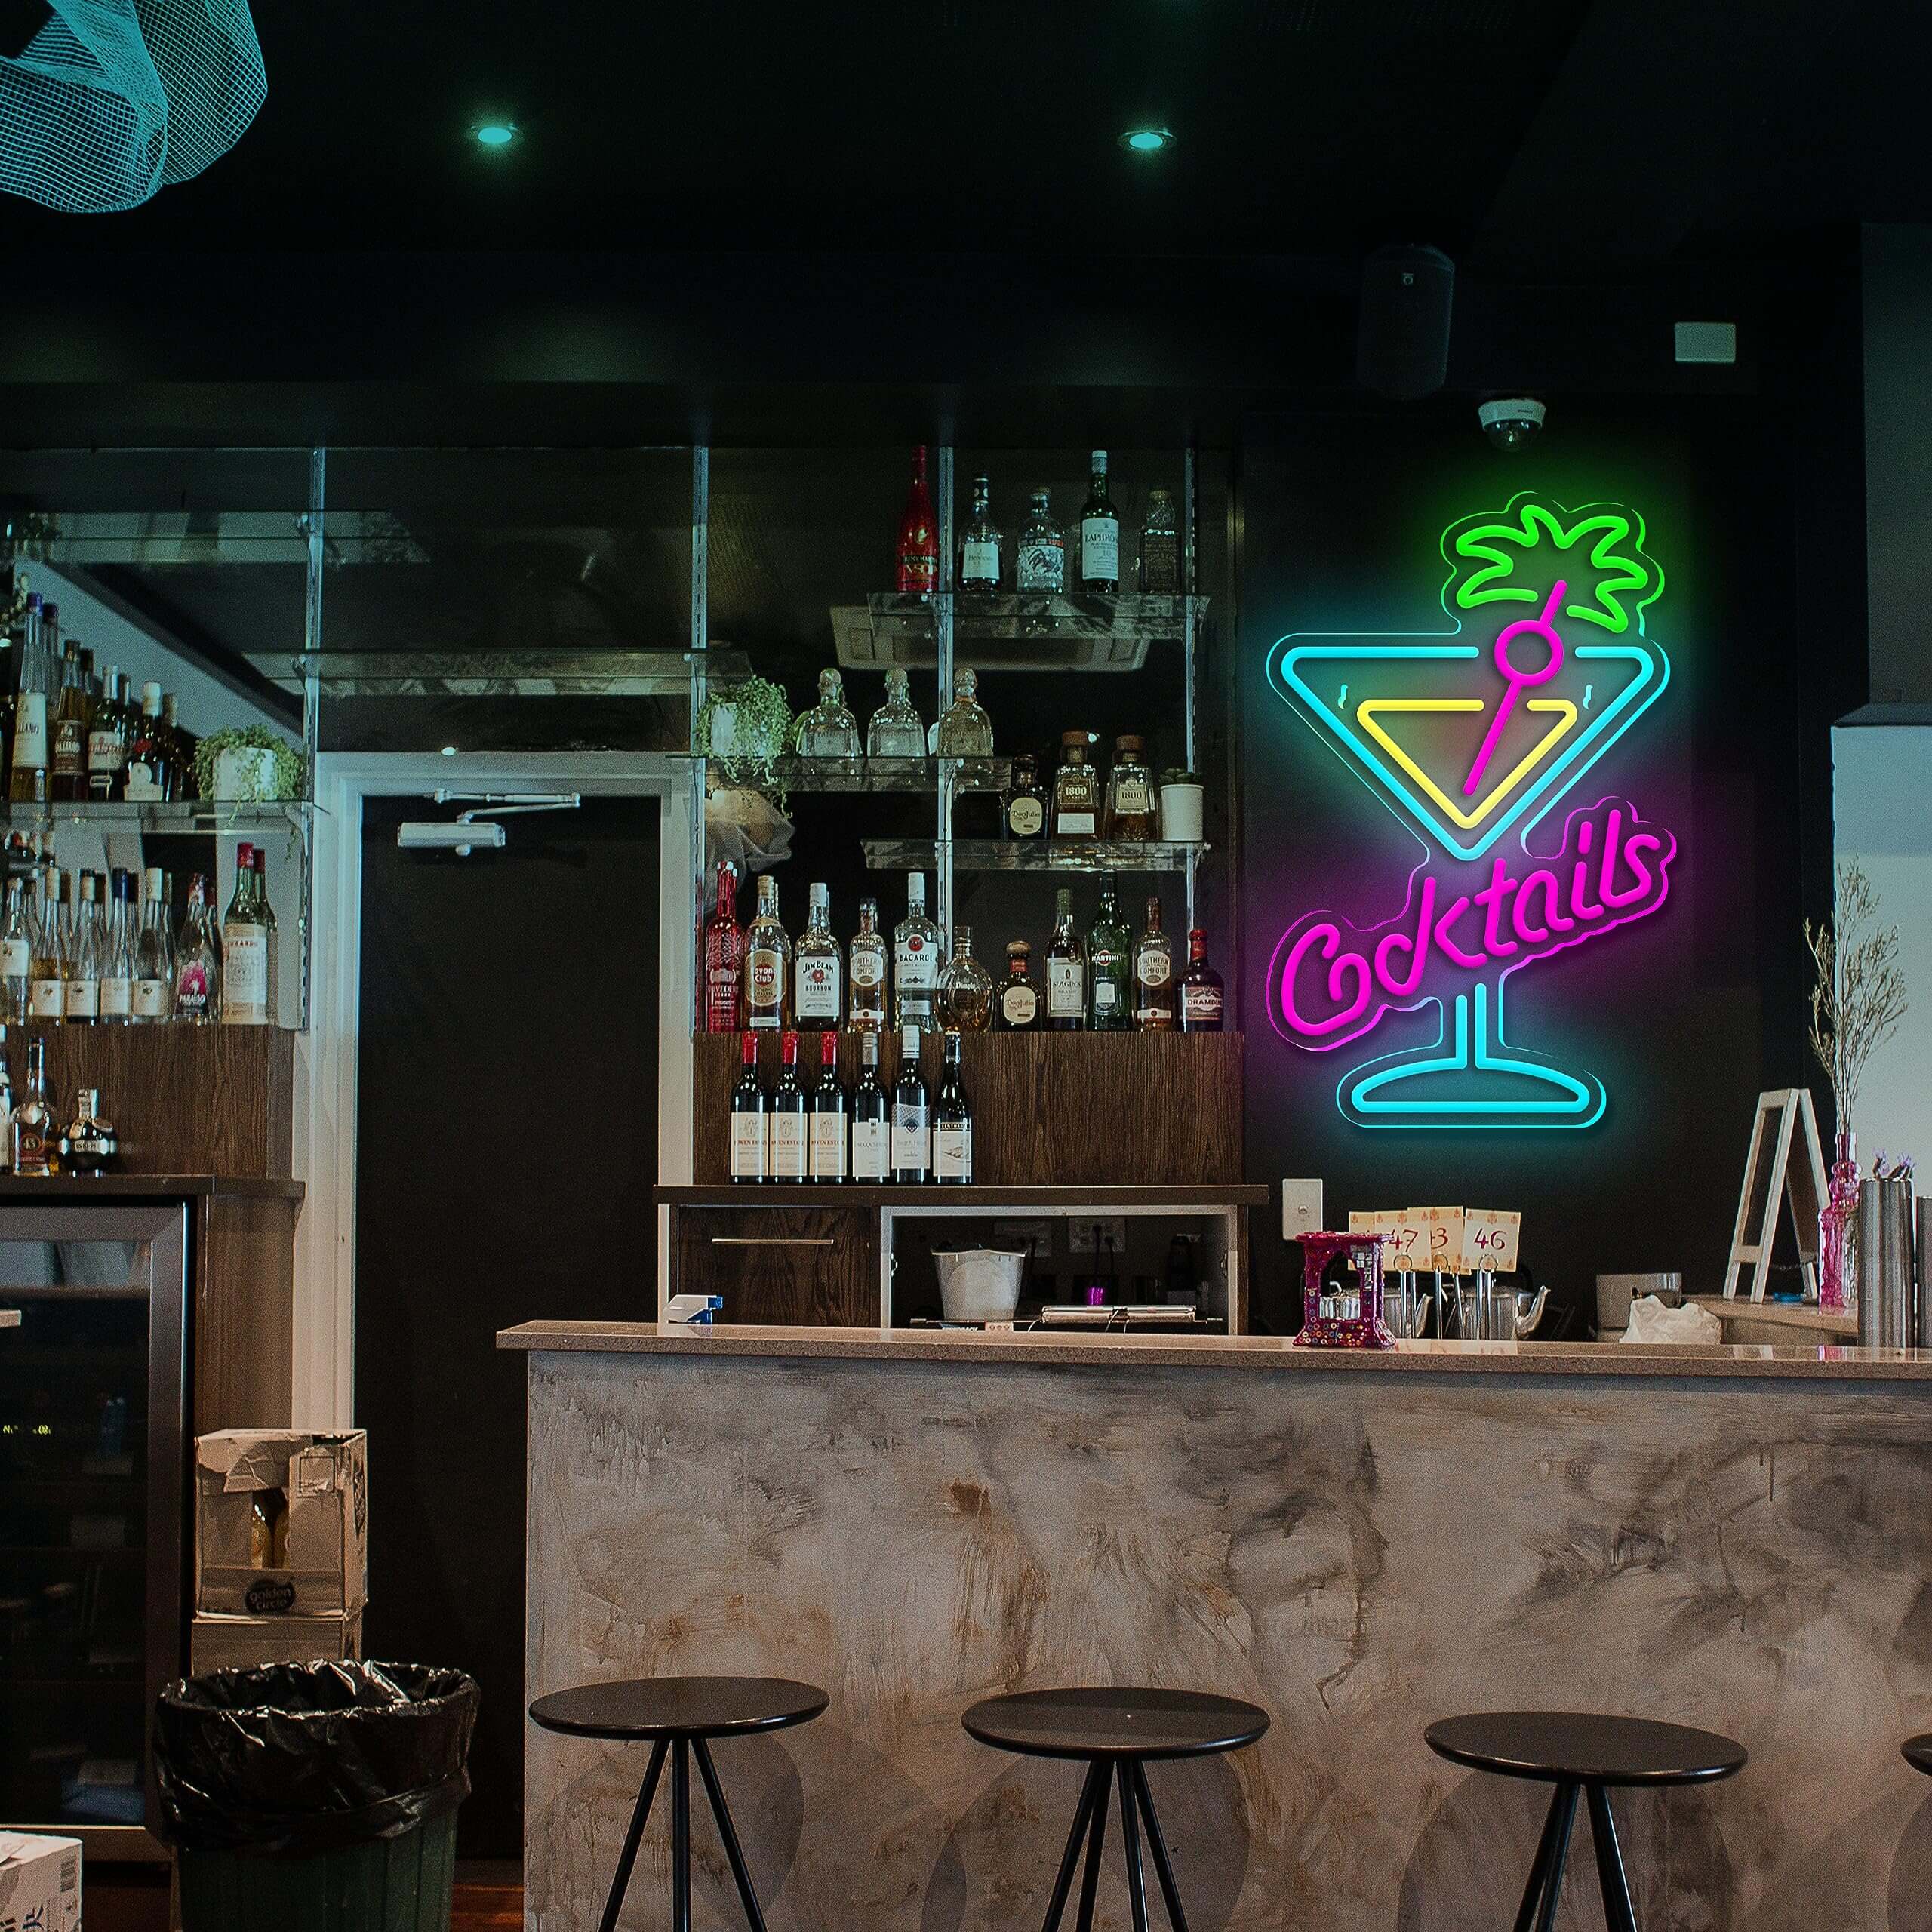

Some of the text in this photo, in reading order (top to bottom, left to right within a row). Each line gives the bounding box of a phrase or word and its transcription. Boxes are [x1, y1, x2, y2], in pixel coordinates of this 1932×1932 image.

[1065, 786, 1088, 796] 1800
[1121, 792, 1142, 800] 1800
[1281, 809, 1661, 1036] Cocktails
[802, 960, 834, 974] JIM BEAM
[755, 974, 773, 983] Club
[1388, 1228, 1419, 1254] 47
[1430, 1227, 1450, 1251] 3
[1473, 1228, 1508, 1251] 46
